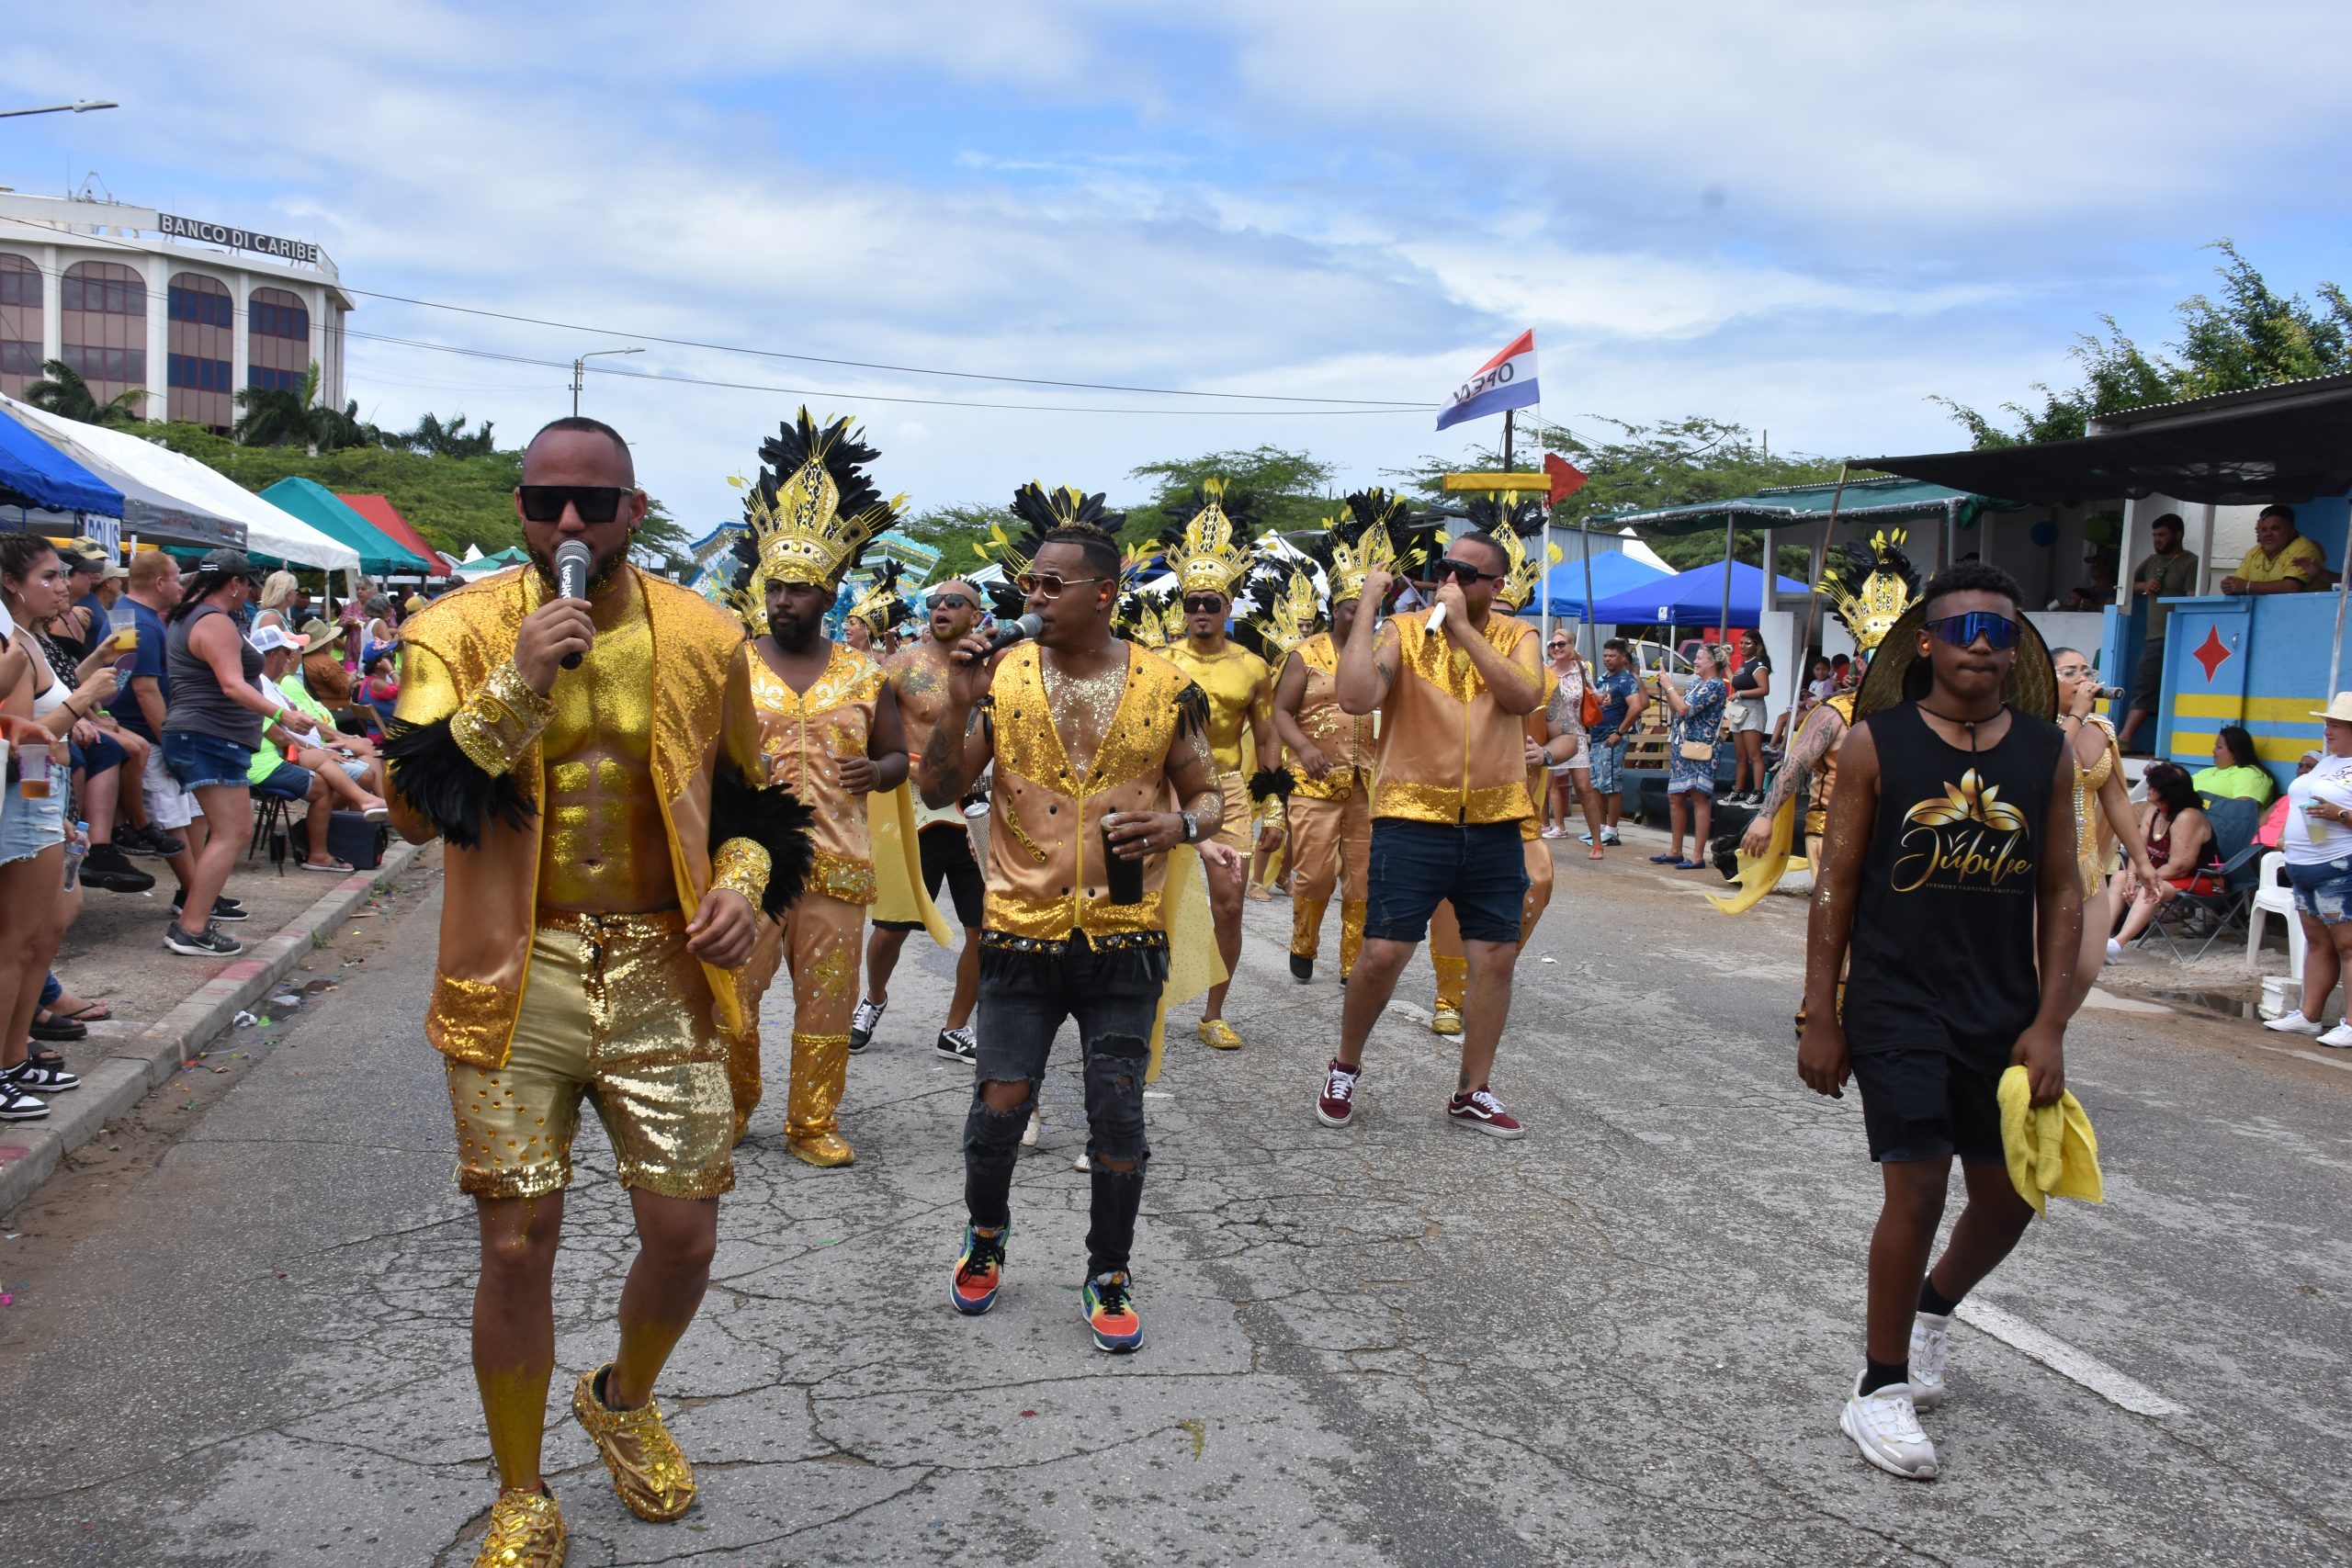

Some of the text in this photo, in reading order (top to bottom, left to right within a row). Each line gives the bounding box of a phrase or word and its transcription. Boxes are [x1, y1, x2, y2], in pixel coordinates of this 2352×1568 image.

[162, 215, 317, 262] BANCO DI CARIBE
